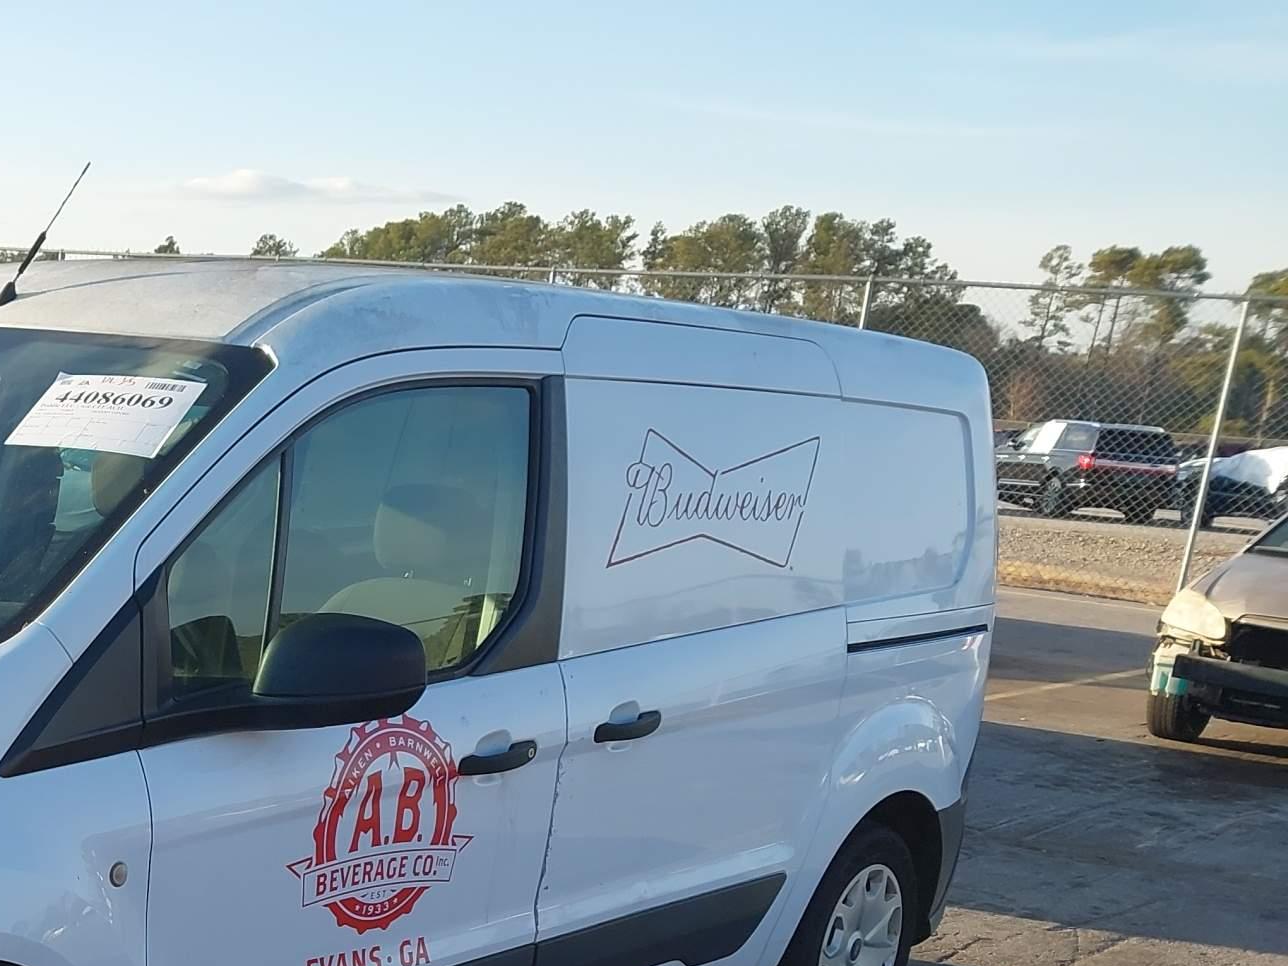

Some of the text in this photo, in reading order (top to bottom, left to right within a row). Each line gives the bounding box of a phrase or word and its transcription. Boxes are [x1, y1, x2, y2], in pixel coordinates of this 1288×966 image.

[55, 389, 174, 410] 44086069
[626, 462, 804, 527] Budweiser
[344, 735, 446, 799] AIKEN BARNWELL
[348, 766, 425, 854] A.B.
[315, 855, 409, 897] BEVERAGE
[412, 854, 438, 877] CO.
[361, 901, 390, 916] 1933
